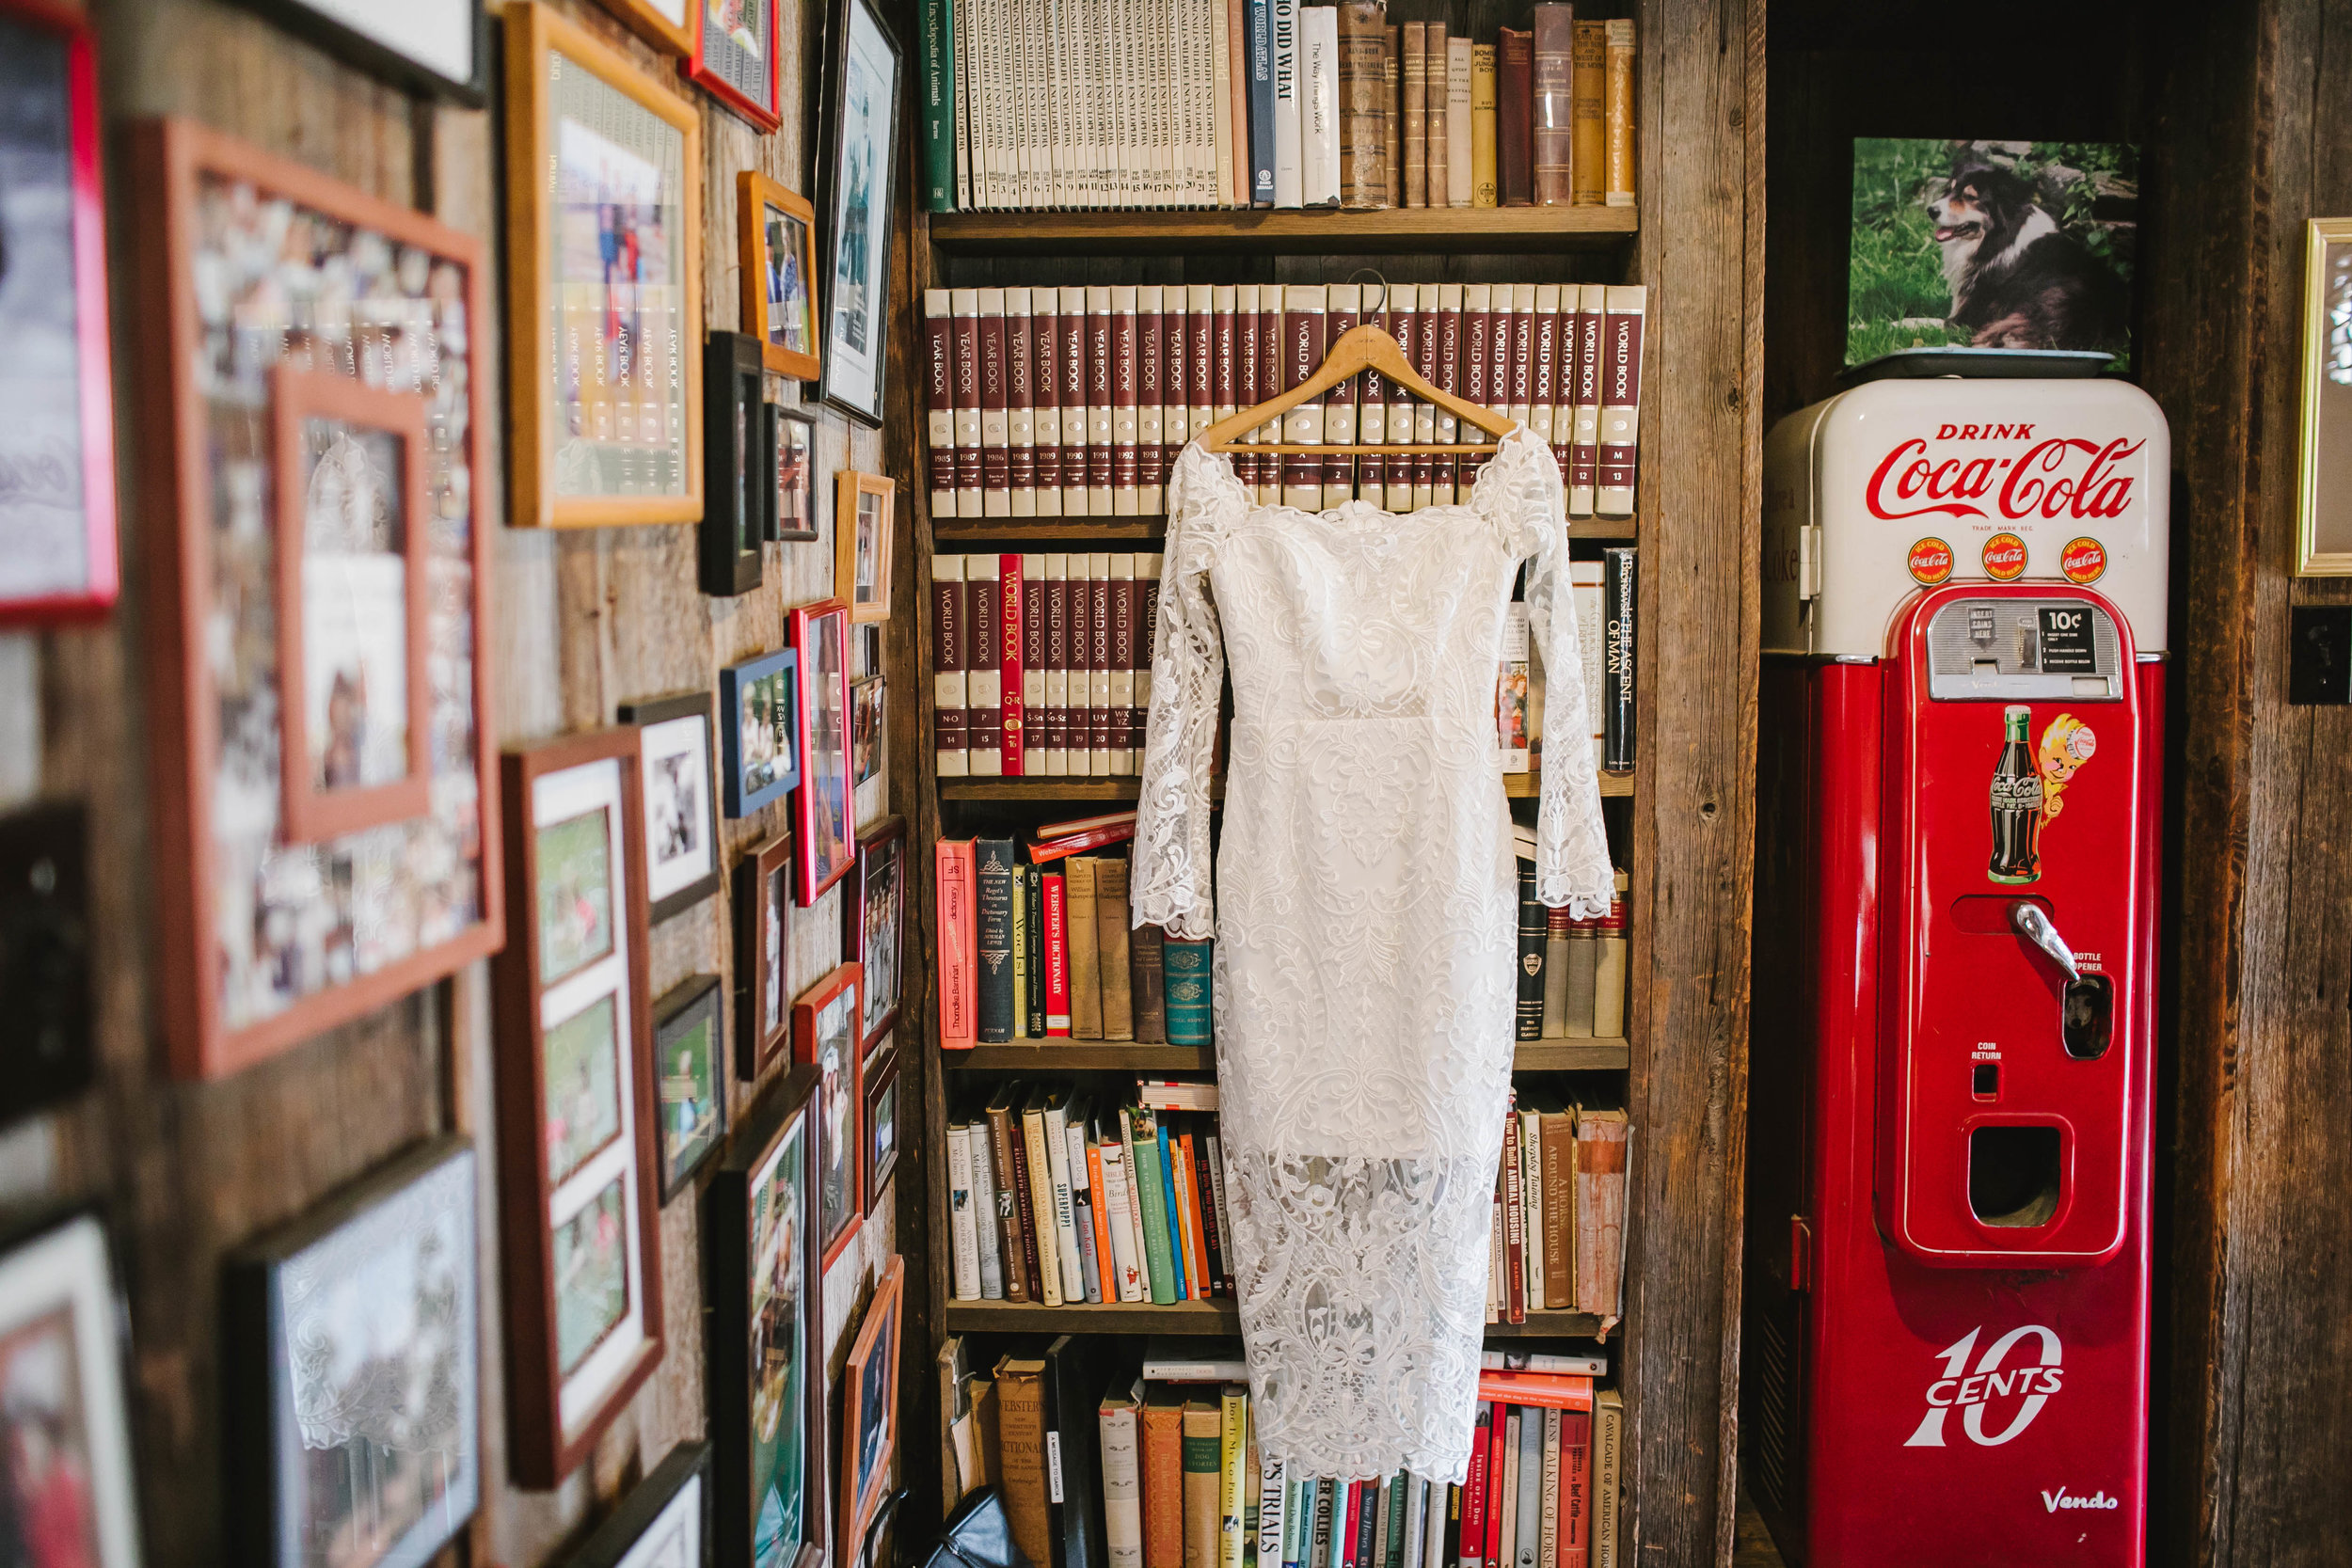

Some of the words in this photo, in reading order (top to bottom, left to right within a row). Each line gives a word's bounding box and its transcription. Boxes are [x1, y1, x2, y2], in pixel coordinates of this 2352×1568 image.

[927, 3, 939, 57] Encyclopedia
[956, 3, 964, 46] WAGNALLS
[1255, 6, 1267, 44] WORLD
[1278, 21, 1292, 52] DID
[930, 59, 940, 69] of
[1256, 46, 1268, 81] ATLAS
[1312, 42, 1321, 59] The
[956, 47, 964, 87] WILDLIFE
[1278, 53, 1292, 101] WHAT
[1311, 61, 1322, 78] Way
[930, 70, 942, 105] Animals
[957, 89, 965, 150] ENCYCLOPEDIA
[1314, 111, 1323, 135] Work
[933, 333, 943, 359] YEAR
[1069, 330, 1078, 356] YEAR
[1120, 329, 1129, 356] YEAR
[1472, 319, 1483, 362] WORLD
[1583, 320, 1596, 363] WORLD
[1617, 321, 1629, 364] WORLD
[934, 362, 945, 394] BOOK
[1069, 359, 1078, 392] BOOK
[1120, 358, 1130, 391] BOOK
[1470, 365, 1482, 397] BOOK
[1582, 365, 1594, 398] BOOK
[1615, 365, 1627, 399] BOOK
[1936, 423, 2036, 440] DRINK
[1143, 451, 1158, 459] 1993
[1581, 451, 1586, 459] L
[1866, 437, 2147, 520] Coca-Cola
[1915, 543, 1927, 553] ICE
[1927, 542, 1945, 551] COLD
[1984, 548, 2023, 563] Coca-Cola
[1989, 538, 2000, 549] ICE
[2000, 537, 2019, 547] COLD
[2066, 544, 2077, 555] ICE
[2077, 540, 2096, 550] COLD
[1911, 552, 1948, 568] Coca-Cola
[1917, 570, 1932, 580] SOLD
[1932, 568, 1947, 579] HERE
[1991, 566, 2006, 576] SOLD
[2007, 564, 2021, 576] HERE
[2064, 550, 2101, 570] Coca-Cola
[2071, 571, 2088, 580] SOLD
[2087, 565, 2102, 579] HERE
[942, 589, 953, 630] WORLD
[1004, 571, 1017, 621] WORLD
[1051, 588, 1061, 628] WORLD
[1608, 620, 1620, 640] OF
[1620, 620, 1631, 647] THE
[2049, 612, 2082, 630] 10¢
[943, 632, 953, 664] BOOK
[1005, 624, 1017, 661] BOOK
[1051, 631, 1061, 663] BOOK
[1608, 640, 1620, 673] MAN
[1620, 651, 1631, 704] ASCENT
[1009, 739, 1017, 748] 16
[981, 909, 1008, 917] Dictionary
[1050, 885, 1061, 938] WEBSTER'S
[1052, 940, 1061, 996] DICTIONARY
[1971, 1051, 2002, 1060] RETURN
[1978, 1042, 1996, 1051] COIN
[1506, 1117, 1516, 1134] How
[1507, 1136, 1517, 1146] to
[1073, 1142, 1082, 1164] Good
[1507, 1147, 1517, 1166] Build
[1528, 1132, 1538, 1171] Sheepdog
[1507, 1169, 1518, 1204] ANIMAL
[1549, 1146, 1558, 1196] AROUND
[1014, 1148, 1024, 1189] ELIZABETH
[1020, 1192, 1028, 1229] MARSHALL
[1024, 1233, 1032, 1264] THOMAS
[1057, 1183, 1071, 1227] SUPERPUPPY
[1529, 1175, 1540, 1210] Training
[1097, 1212, 1105, 1236] America
[1509, 1205, 1519, 1244] HOUSING
[1549, 1199, 1558, 1226] THE
[1559, 1190, 1568, 1228] HORSE
[1084, 1237, 1092, 1257] Katz
[1549, 1227, 1559, 1264] HOUSE
[1903, 1324, 2062, 1447] 10
[1926, 1367, 2064, 1406] CENTS
[1604, 1415, 1613, 1469] CAVALCADE
[1474, 1454, 1484, 1482] INSIDE
[1545, 1449, 1557, 1501] TALKING
[1604, 1473, 1613, 1485] OF
[1290, 1482, 1297, 1491] So
[1475, 1486, 1482, 1496] OF
[1571, 1483, 1581, 1497] Beef
[2041, 1486, 2118, 1513] Vendo
[1261, 1485, 1281, 1553] TRIALS
[1286, 1509, 1295, 1525] Dog
[1315, 1498, 1331, 1545] COLLIES
[1363, 1496, 1373, 1517] Some
[1544, 1506, 1555, 1522] OF
[1570, 1499, 1581, 1518] Cattle
[1602, 1489, 1612, 1541] AMERICAN
[1361, 1520, 1372, 1548] Horses
